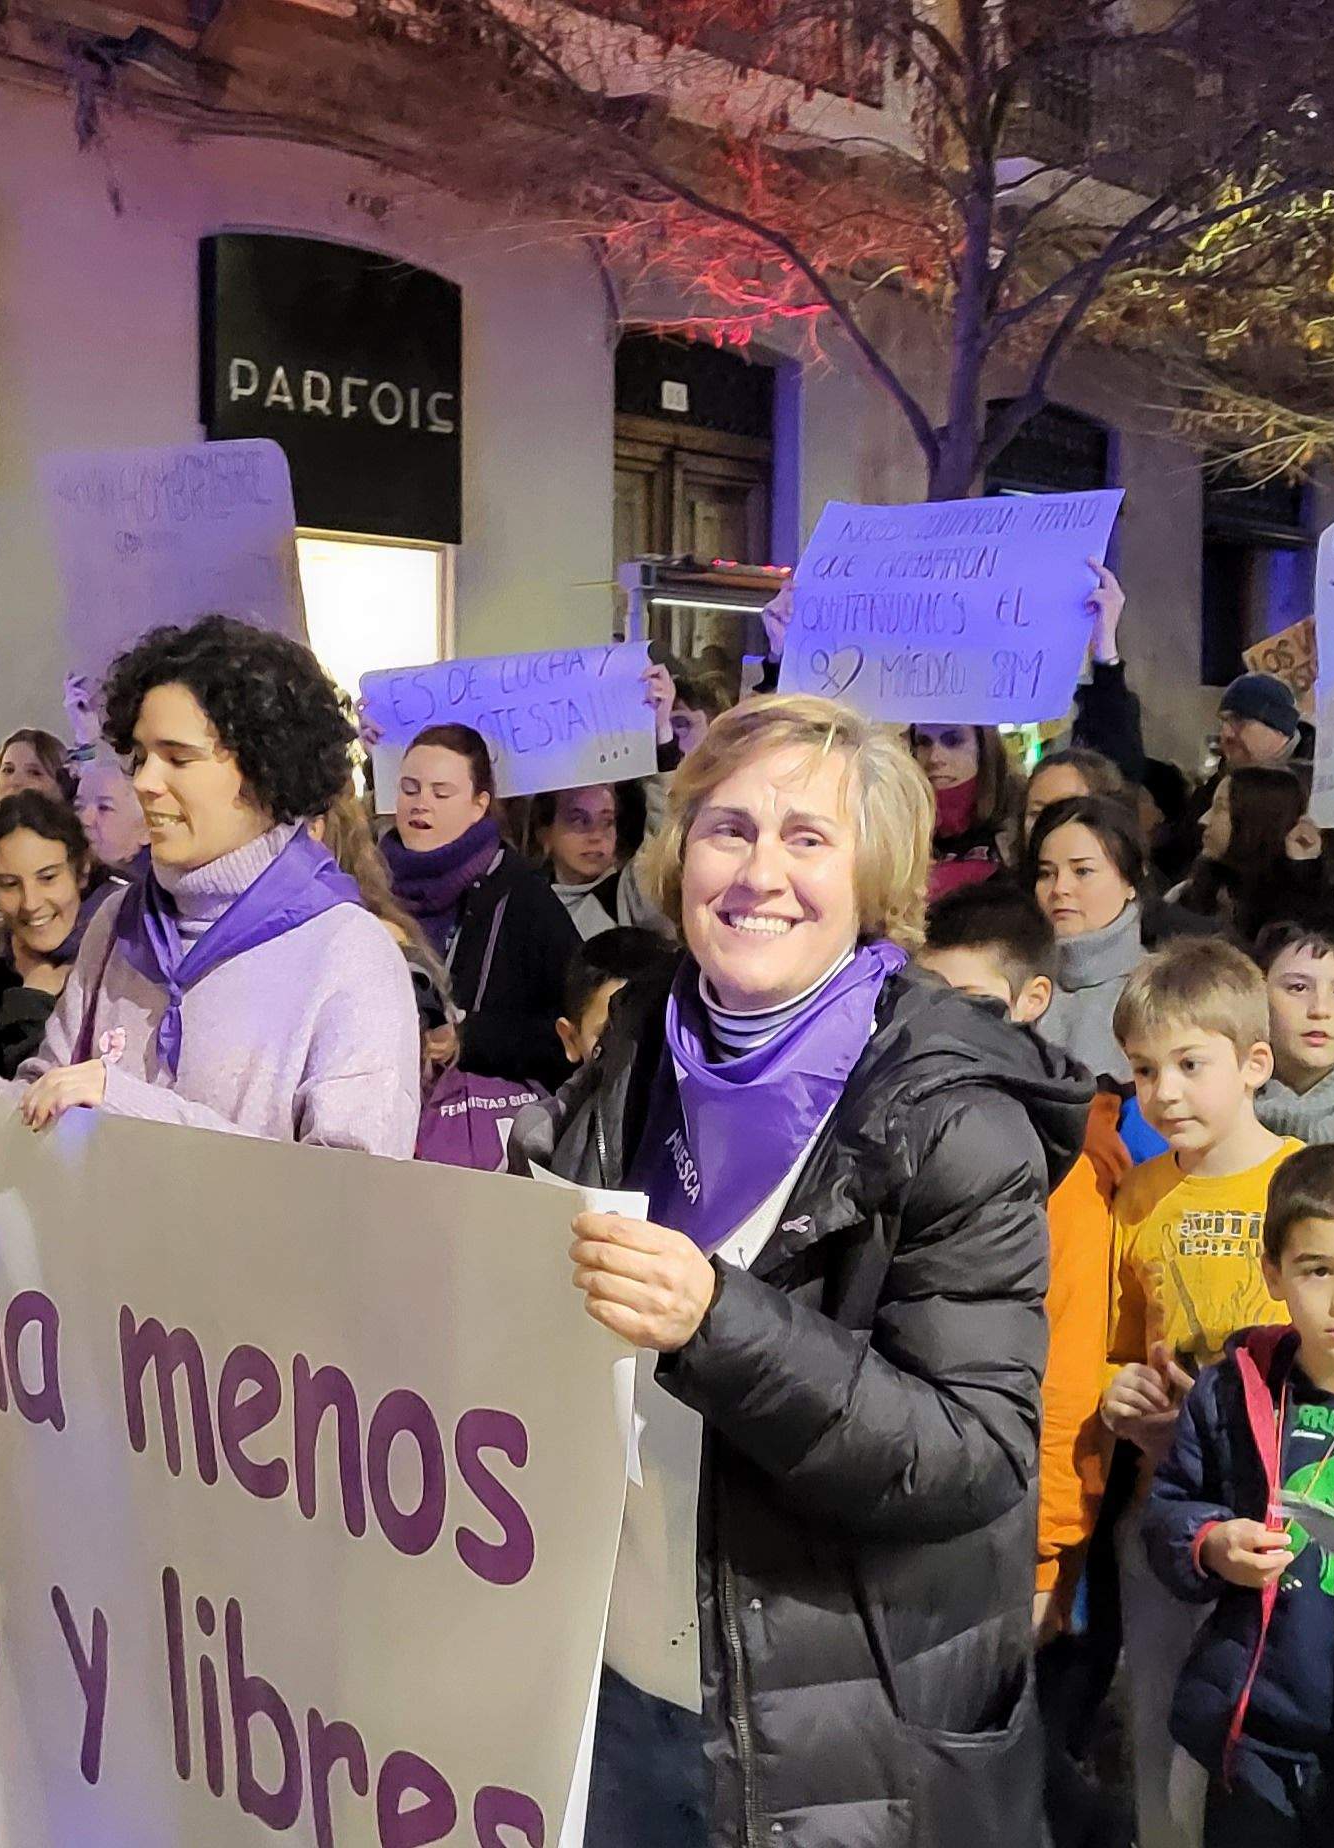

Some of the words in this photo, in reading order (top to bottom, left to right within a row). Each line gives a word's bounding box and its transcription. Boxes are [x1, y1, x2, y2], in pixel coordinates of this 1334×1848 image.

[229, 358, 454, 433] PARFOIS
[389, 674, 436, 726] ES
[446, 666, 482, 706] DE
[500, 651, 586, 694] LUCHA
[597, 646, 617, 677] Y
[664, 1128, 701, 1205] HUESCA
[119, 1303, 535, 1586] menos
[51, 1585, 109, 1785] y
